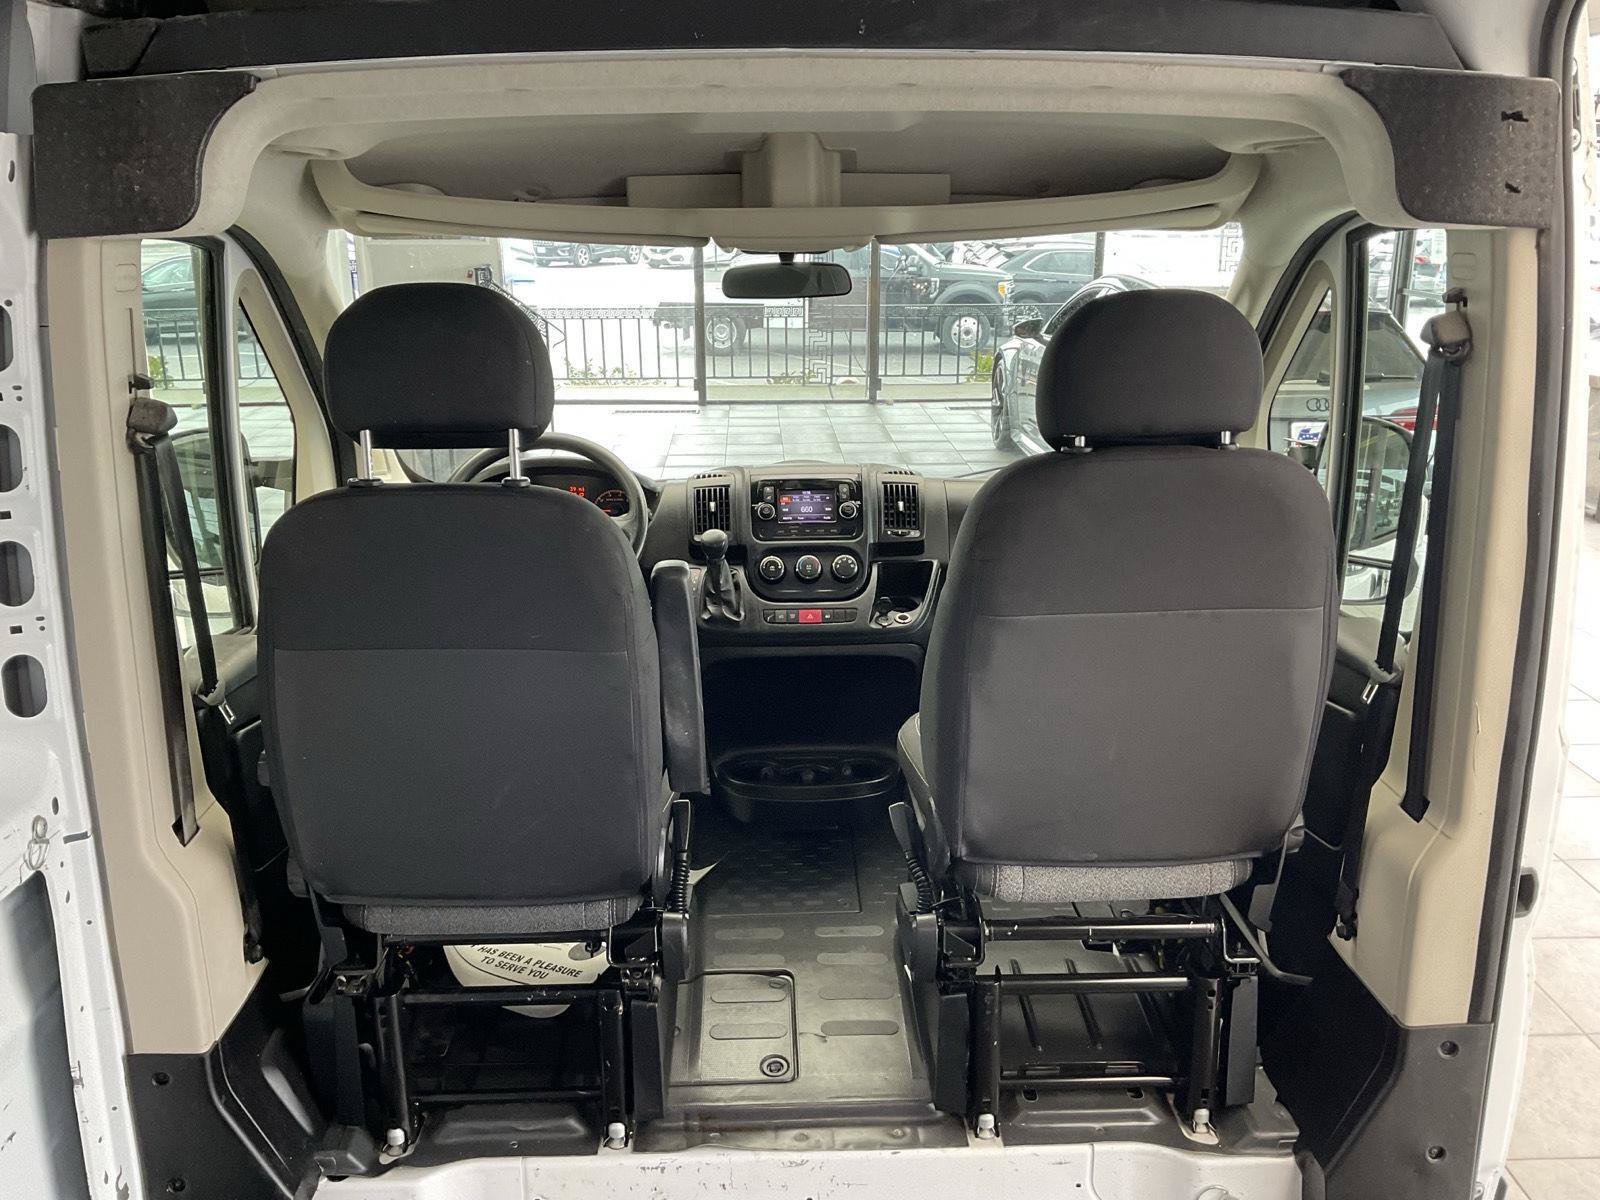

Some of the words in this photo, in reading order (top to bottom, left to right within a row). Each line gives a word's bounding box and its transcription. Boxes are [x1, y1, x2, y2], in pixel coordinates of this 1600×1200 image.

[800, 505, 813, 513] 660
[477, 945, 498, 956] HAS
[498, 950, 523, 963] BEEN
[524, 957, 533, 965] A
[533, 959, 583, 978] PLEASURE
[480, 956, 493, 965] TO
[495, 960, 527, 974] SERVE
[527, 968, 549, 979] YOU
